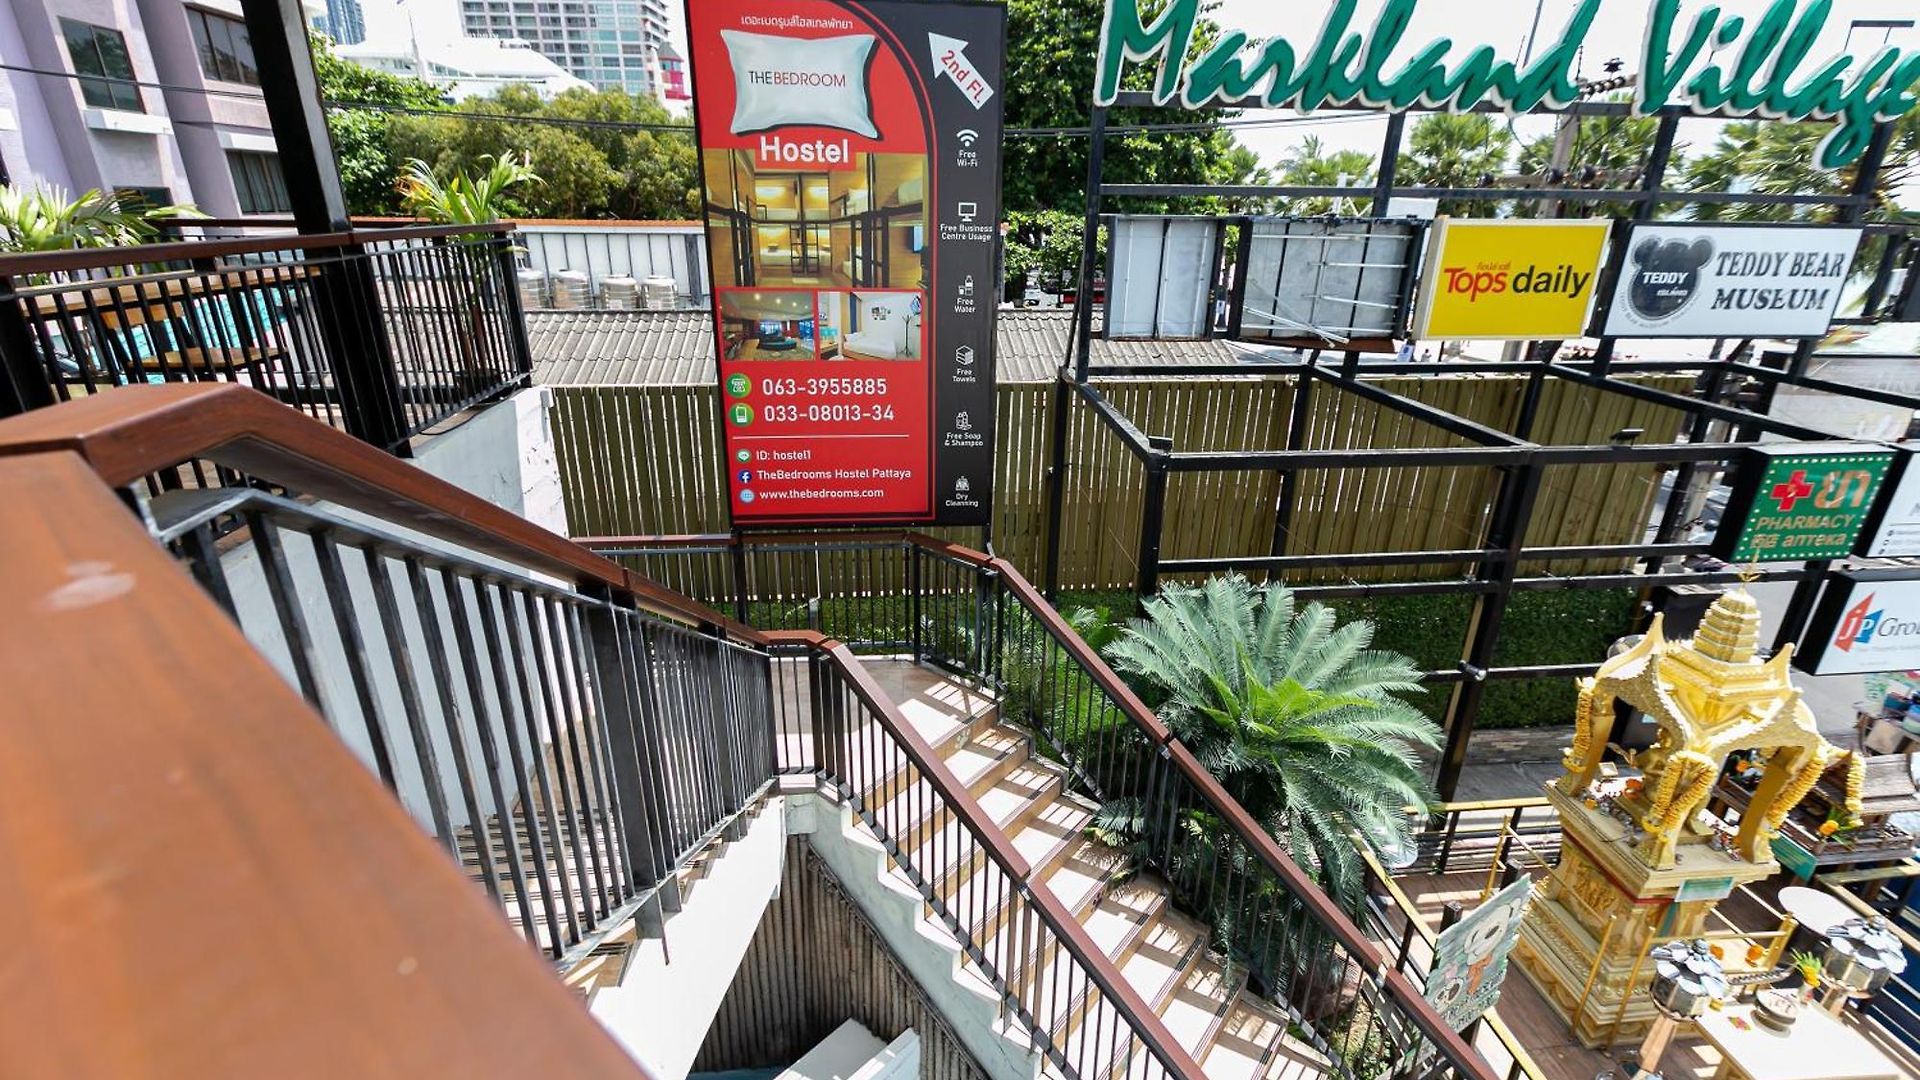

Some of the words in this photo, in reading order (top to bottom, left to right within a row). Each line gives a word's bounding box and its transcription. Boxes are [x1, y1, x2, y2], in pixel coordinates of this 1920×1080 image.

[941, 50, 970, 82] 2nd
[1095, 0, 1601, 116] Markland
[1629, 0, 1920, 170] Village
[760, 135, 849, 163] Hostel
[959, 150, 976, 158] Free
[957, 158, 978, 167] Wi-Fi
[940, 224, 957, 232] Free
[959, 224, 993, 232] Business
[942, 232, 966, 240] Centre
[968, 233, 992, 242] Usage
[1715, 251, 1789, 277] TEDDY
[1788, 253, 1846, 277] BEAR
[1444, 267, 1508, 302] Tops
[1512, 265, 1591, 299] daily
[1642, 272, 1689, 284] TEDDY
[957, 298, 974, 306] Free
[1710, 288, 1830, 310] MUSEUM
[954, 305, 976, 313] Water
[957, 368, 973, 376] Free
[952, 375, 976, 383] Towels
[762, 378, 888, 396] 063-3955885
[764, 404, 894, 422] 033-08013-34
[946, 432, 962, 440] Free
[951, 439, 984, 447] Shampoo
[756, 450, 771, 461] ID:
[757, 470, 832, 481] TheBedrooms
[835, 468, 869, 479] Hostel
[872, 467, 911, 483] Pattaya
[759, 489, 884, 500] www.thebedrooms.com
[1754, 514, 1857, 531] PHARMACY
